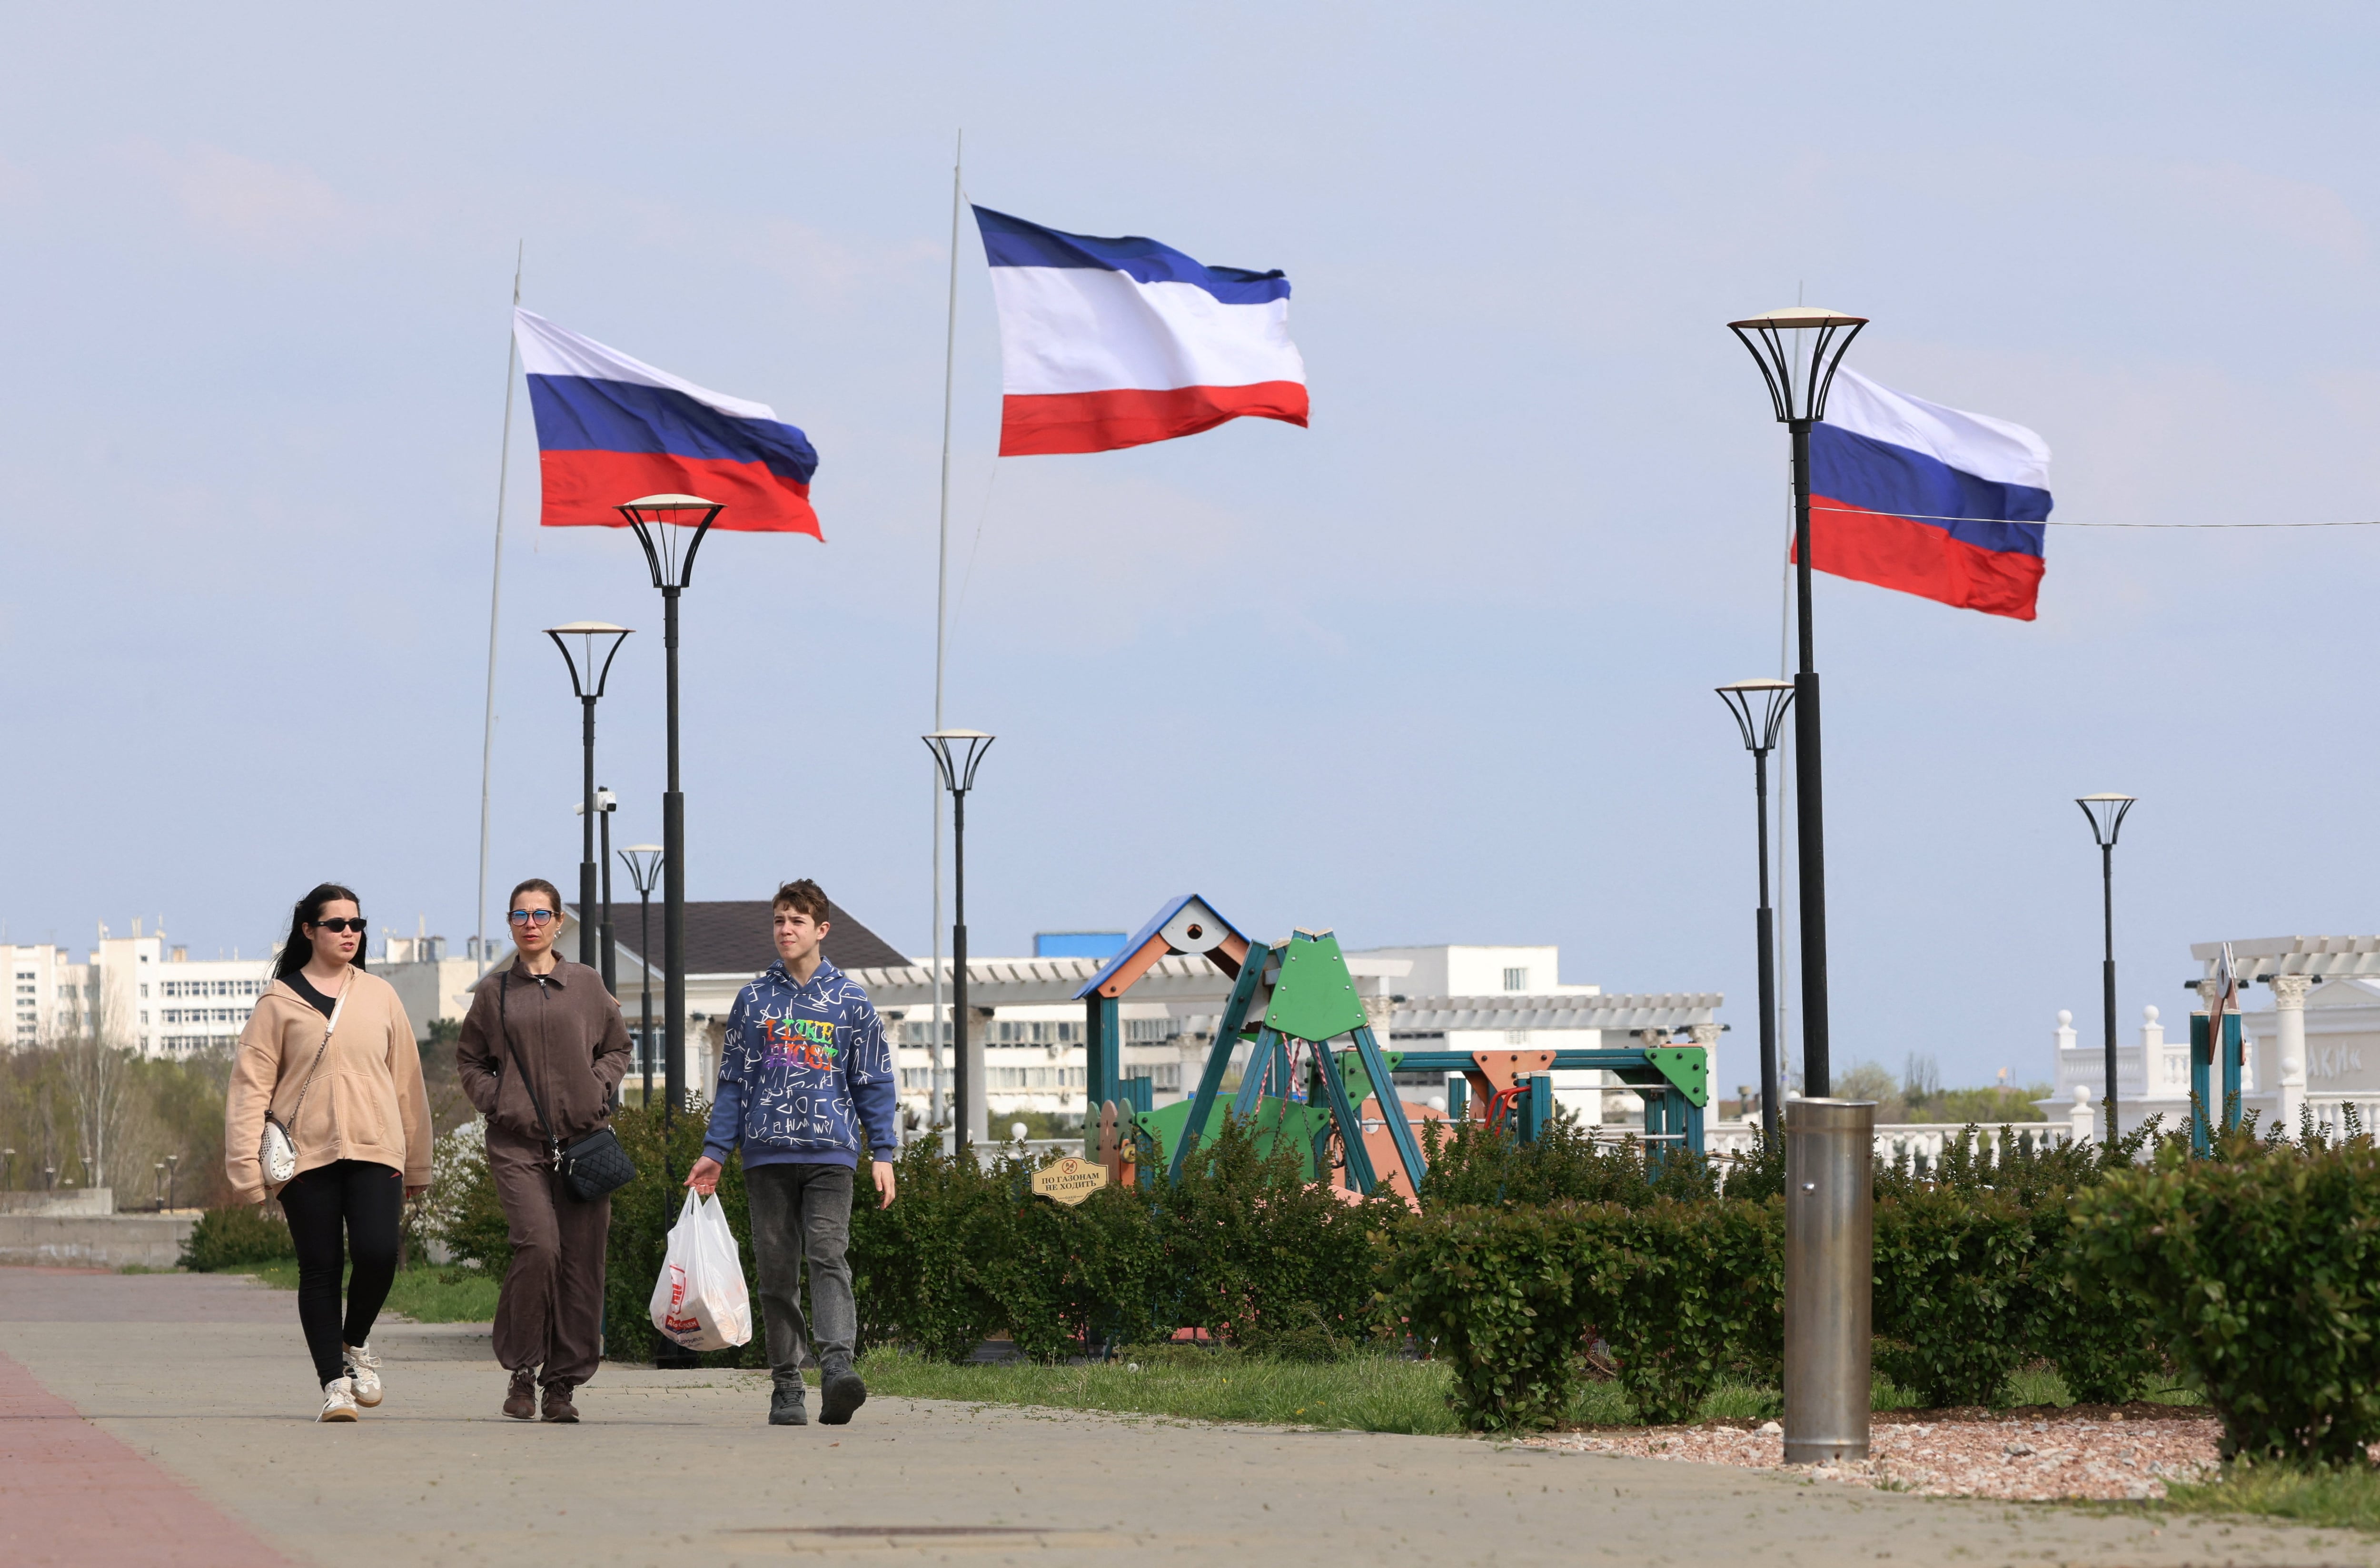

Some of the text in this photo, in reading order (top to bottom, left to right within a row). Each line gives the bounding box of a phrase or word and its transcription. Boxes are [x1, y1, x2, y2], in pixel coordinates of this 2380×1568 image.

[765, 1019, 834, 1044] I LIKE
[763, 1043, 839, 1071] GHOST
[1057, 1173, 1100, 1183] ГАЗОНАМ
[1060, 1180, 1096, 1190] ХОДИТЬ
